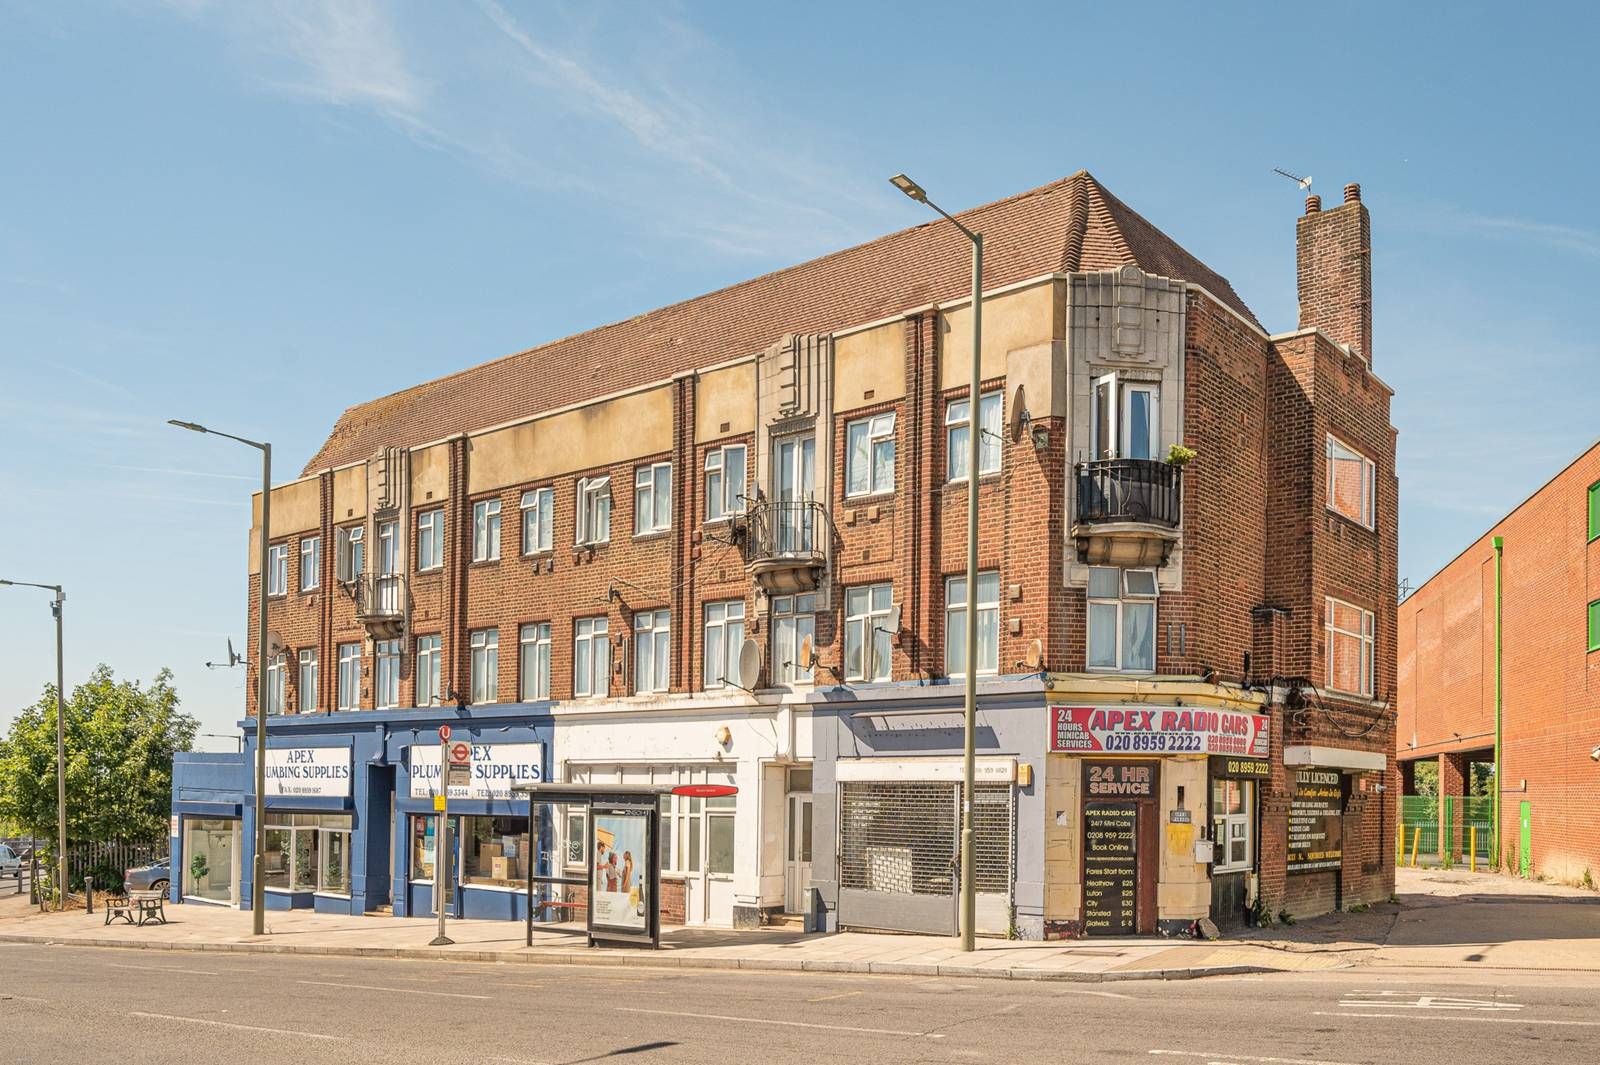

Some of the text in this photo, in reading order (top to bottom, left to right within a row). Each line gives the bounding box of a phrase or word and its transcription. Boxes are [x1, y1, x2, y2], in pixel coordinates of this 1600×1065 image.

[1058, 710, 1072, 722] 24
[1057, 723, 1082, 731] HOURS
[1090, 710, 1248, 736] APEX RADIO CARS
[1057, 732, 1090, 740] MINICAB
[1057, 740, 1092, 748] SERVICES
[1106, 735, 1202, 750] 020 8959 2222
[286, 750, 314, 763] APEX
[302, 766, 348, 778] SUPPLIES
[476, 764, 540, 780] SUPPLIES
[1228, 761, 1269, 774] 020 8959 2222
[1090, 766, 1150, 782] 24 HR
[1090, 782, 1150, 794] SERVICE
